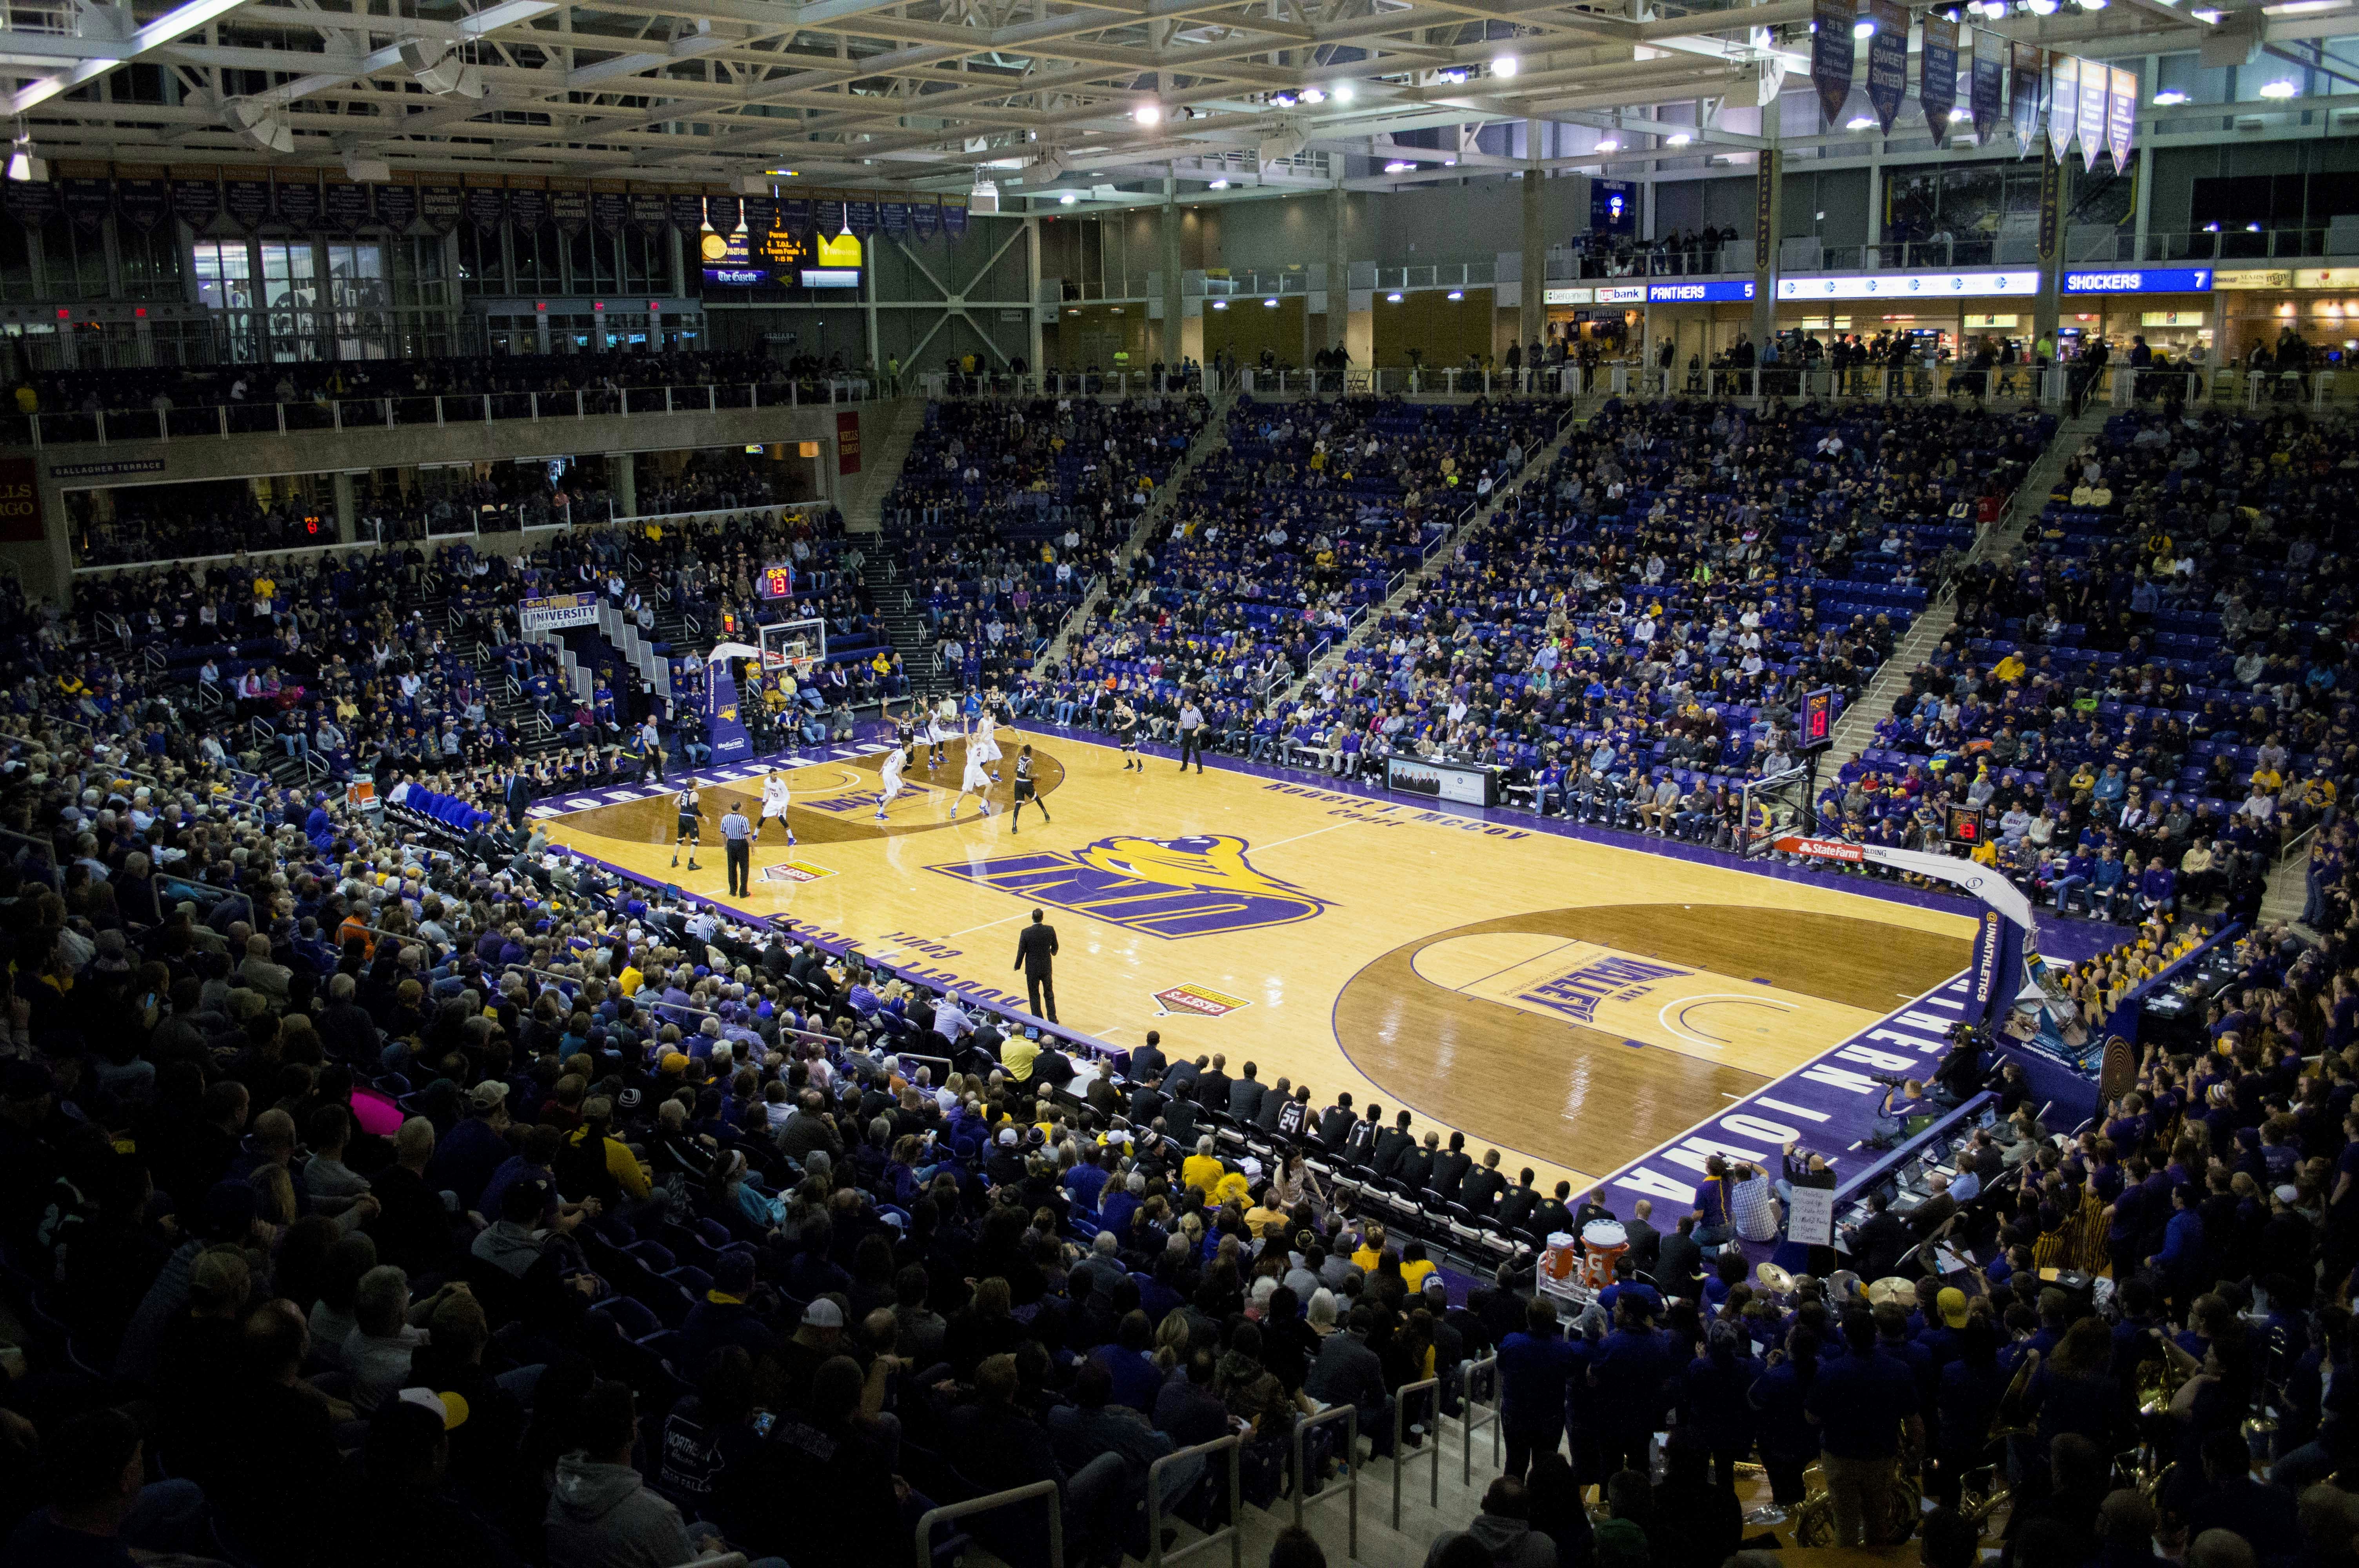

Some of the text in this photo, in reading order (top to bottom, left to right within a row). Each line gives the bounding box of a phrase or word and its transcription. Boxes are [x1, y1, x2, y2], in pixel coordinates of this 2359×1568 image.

[1873, 47, 1905, 69] SWEET
[1872, 67, 1903, 89] SIXTEEN
[424, 195, 458, 204] SWEET
[554, 199, 585, 208] SWEET
[425, 205, 459, 214] SIXTEEN
[553, 209, 586, 218] SIXTEEN
[634, 211, 665, 220] SIXTEEN
[2045, 211, 2054, 255] PATIO
[1759, 225, 1767, 265] PATIO
[717, 272, 757, 281] The Gazette
[2067, 274, 2140, 290] SHOCKERS
[2194, 273, 2205, 288] 7
[1650, 286, 1705, 300] PANTHERS
[1744, 284, 1752, 297] 5
[840, 430, 858, 442] WELLS
[841, 443, 859, 455] FARGO
[56, 461, 161, 476] GALLAGHER TERRACE
[767, 568, 787, 579] 15:24
[773, 578, 785, 593] 13
[527, 595, 578, 610] Get POWER
[523, 606, 596, 631] UNIVERSITY
[568, 617, 594, 626] SUPPLY
[718, 703, 738, 715] UNI
[718, 740, 742, 749] Mediacom
[527, 757, 821, 819] NORTHERN
[681, 796, 688, 806] 31
[1263, 782, 1375, 808] Robert
[1375, 805, 1403, 815] J.
[1863, 848, 1886, 857] ALDING
[1977, 911, 1997, 1002] @UNIATHLETICS
[1500, 973, 1549, 996] CONFERENCE
[1517, 956, 1695, 1023] VALLEY
[1613, 985, 1654, 1002] THE
[1164, 991, 1226, 1014] CASEY'S
[2021, 1042, 2071, 1067] UniversityMills.com
[1279, 1113, 1300, 1134] 24
[1355, 1131, 1364, 1148] 1
[1613, 1096, 1832, 1204] IOWA
[1548, 1250, 1556, 1261] G
[1588, 1254, 1603, 1271] G
[681, 1477, 712, 1494] FALLS
